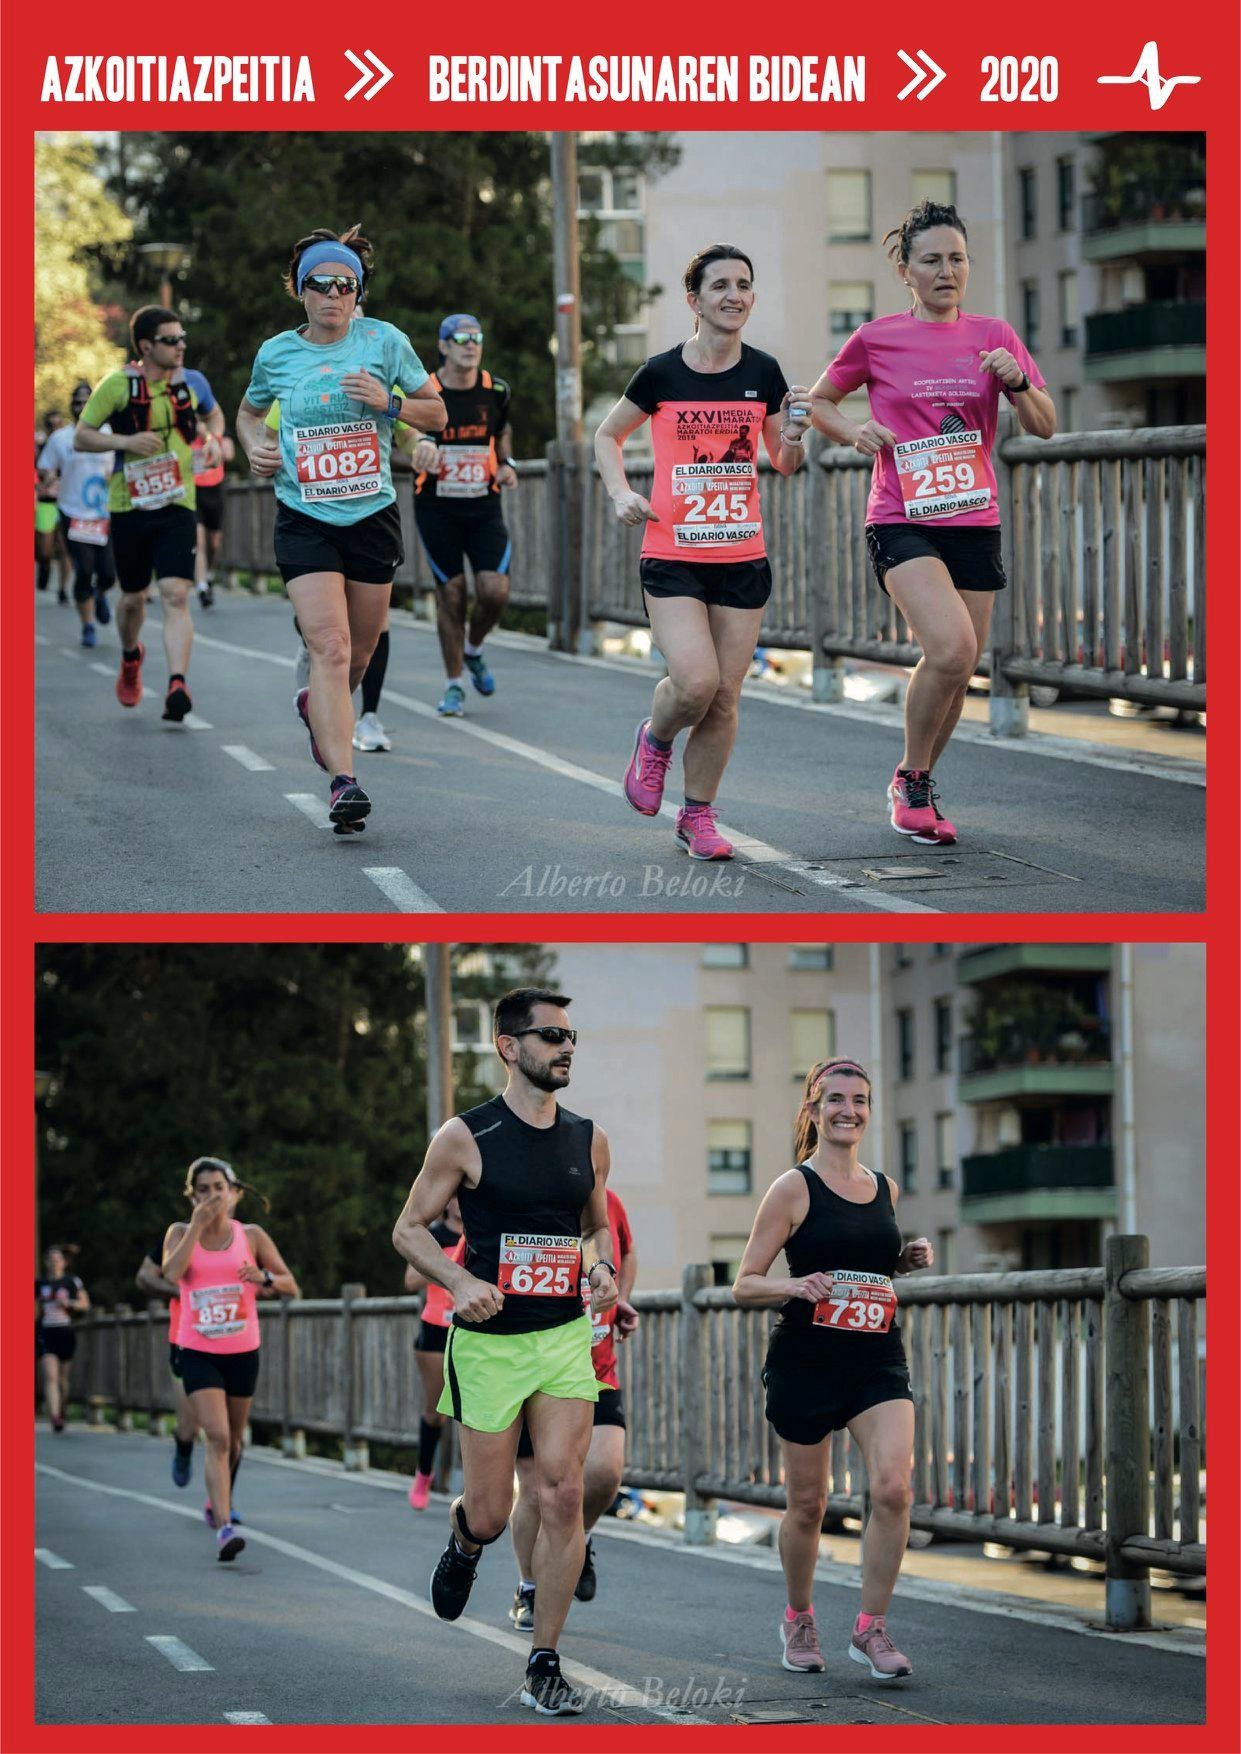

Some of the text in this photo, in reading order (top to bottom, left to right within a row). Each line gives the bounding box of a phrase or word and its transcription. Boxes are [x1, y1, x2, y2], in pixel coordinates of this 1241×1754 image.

[676, 410, 722, 423] XXVI
[297, 422, 373, 438] EL DIARIO VASCO
[897, 433, 977, 455] EL DIARIO VASCO
[301, 448, 377, 480] 1082
[443, 464, 485, 481] 249
[675, 465, 753, 476] EL DIARIO VASCO
[134, 472, 176, 495] 955
[305, 488, 315, 496] EL
[316, 485, 347, 496] DIARIO
[348, 480, 379, 492] VASCO
[912, 463, 975, 497] 259
[684, 493, 749, 522] 245
[909, 508, 922, 517] EL
[922, 501, 956, 515] DIARIO
[957, 496, 987, 508] VASCO
[677, 530, 756, 541] EL DIARIO VASCO
[518, 1236, 553, 1247] DIARIO
[511, 1265, 570, 1294] 625
[837, 1272, 868, 1283] DIARIO
[199, 1304, 238, 1324] 857
[828, 1298, 885, 1329] 739
